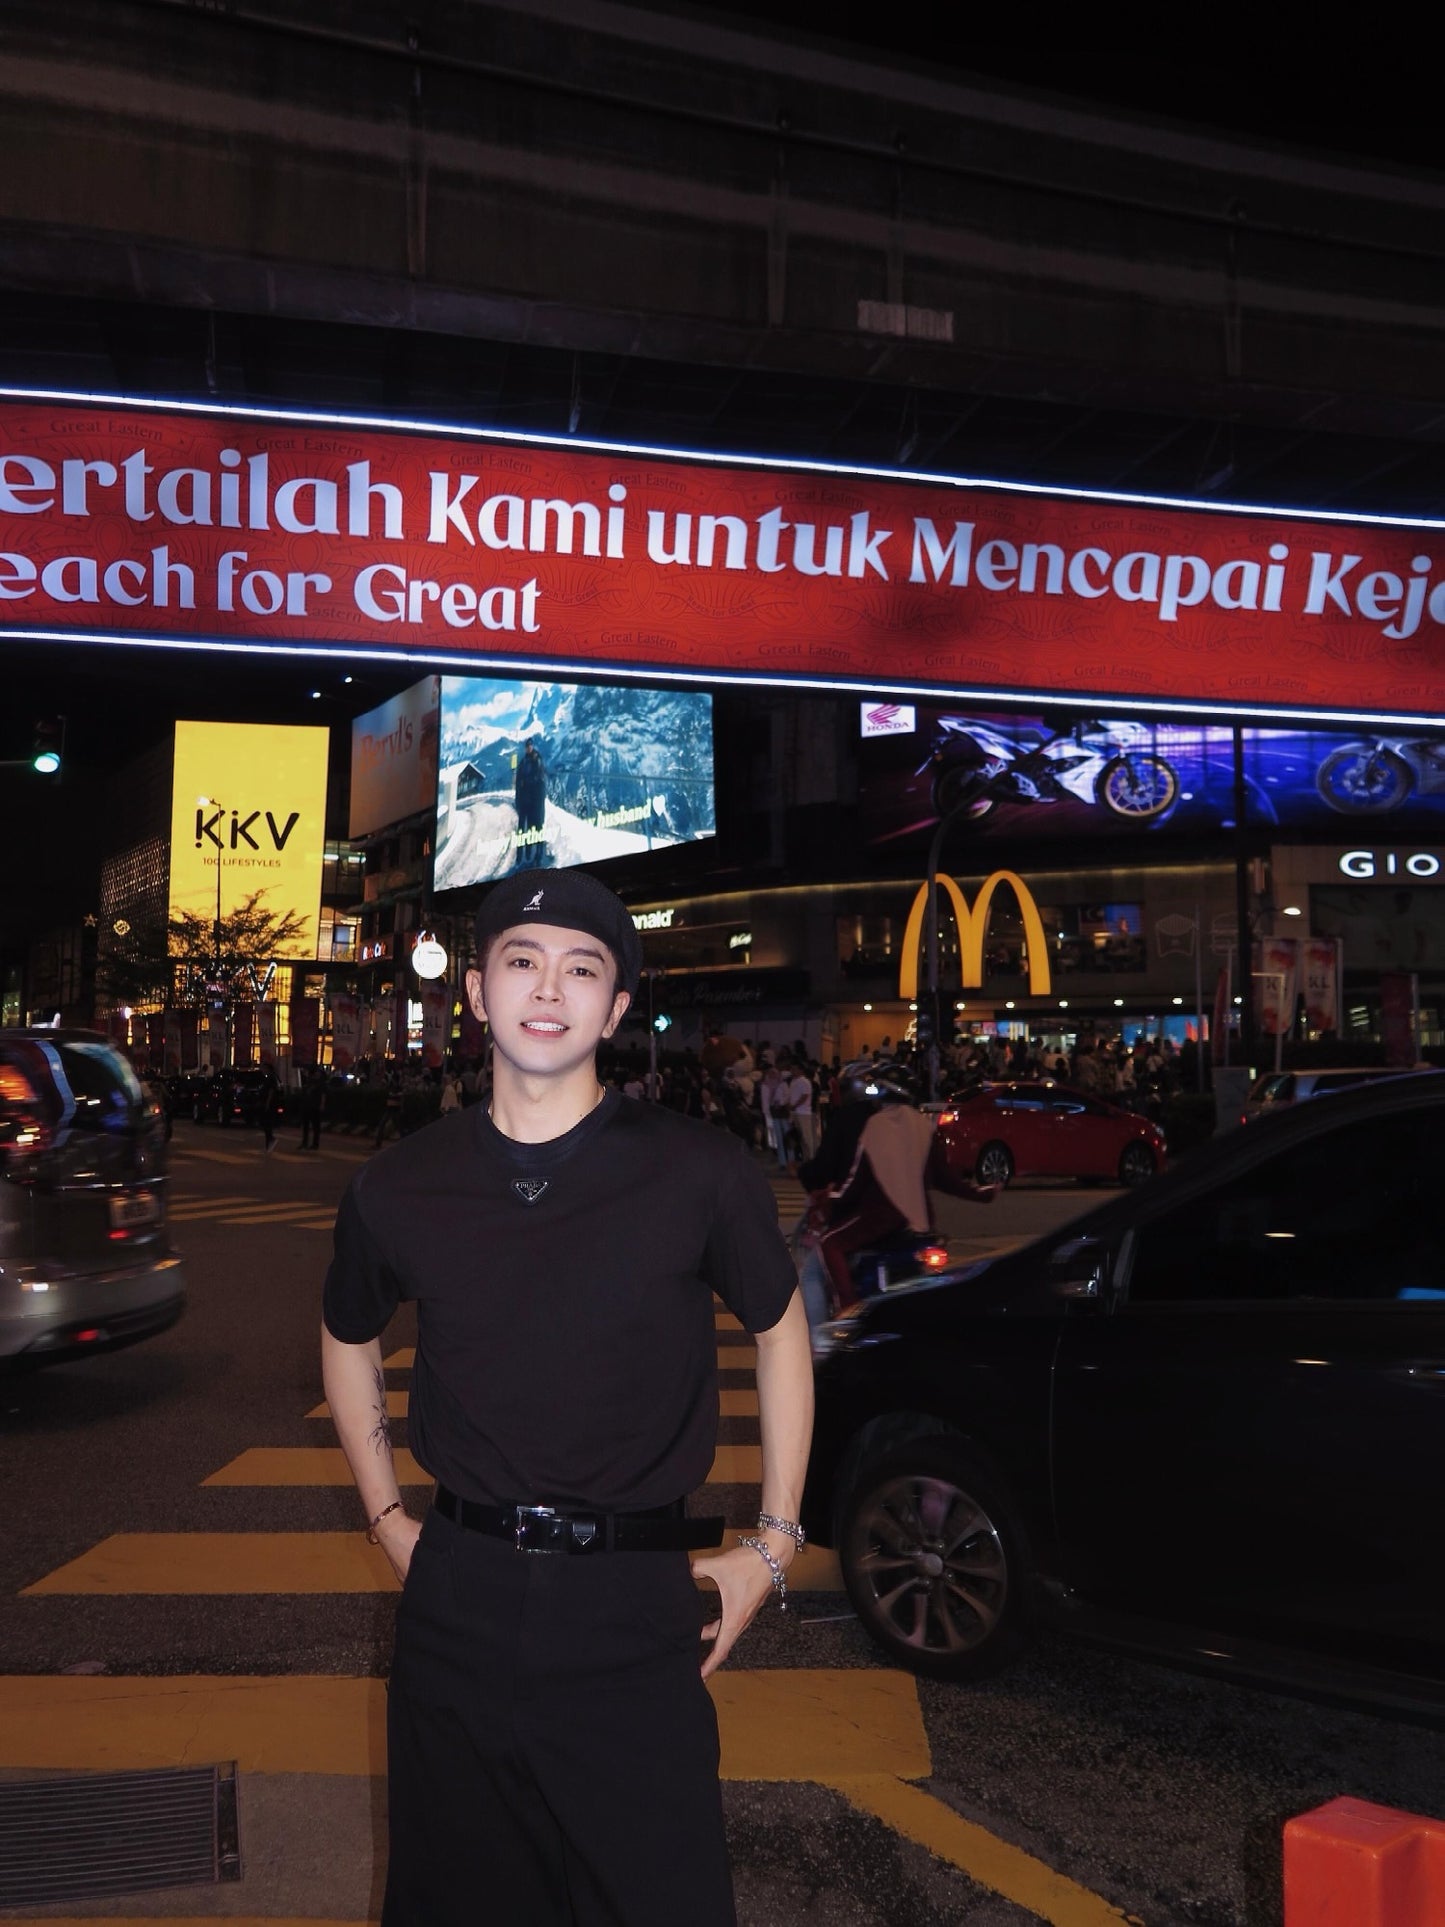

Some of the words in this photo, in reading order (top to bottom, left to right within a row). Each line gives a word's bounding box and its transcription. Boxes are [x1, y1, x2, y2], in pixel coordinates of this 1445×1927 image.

[0, 448, 404, 539] ertailah
[427, 471, 628, 559] Kami
[647, 505, 894, 582] untuk
[908, 516, 1290, 623] Mencapai
[0, 545, 196, 609] each
[217, 551, 333, 617] for
[353, 563, 543, 633] Great
[307, 604, 362, 625] astern
[866, 722, 910, 732] HONDA
[597, 798, 652, 828] husband
[195, 809, 300, 852] KKV
[511, 824, 560, 848] birthd
[222, 857, 282, 869] LIFESTYLES
[1339, 850, 1440, 878] GIO
